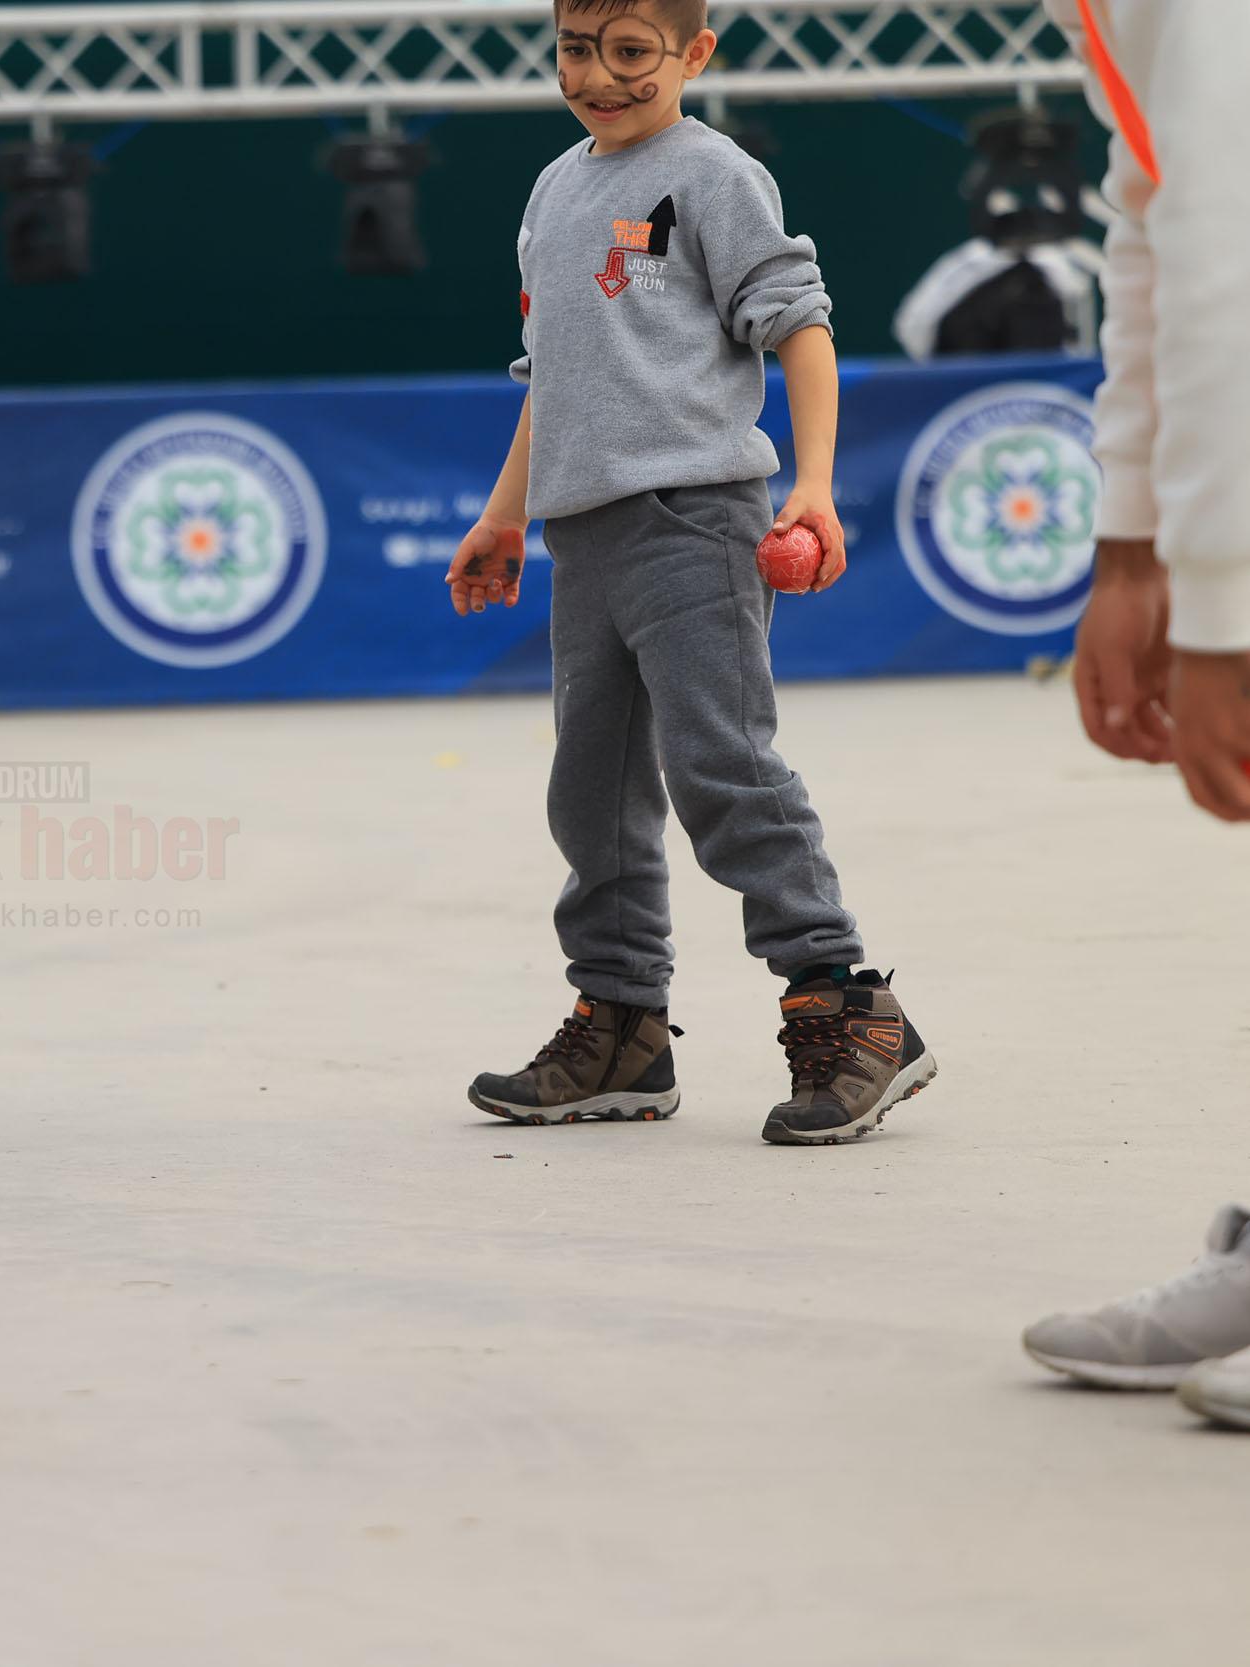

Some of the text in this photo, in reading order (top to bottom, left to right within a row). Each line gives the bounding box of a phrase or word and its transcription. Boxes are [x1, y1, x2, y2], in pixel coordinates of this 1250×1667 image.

[615, 231, 649, 247] THIS
[628, 258, 668, 274] JUST
[632, 274, 665, 291] RUN
